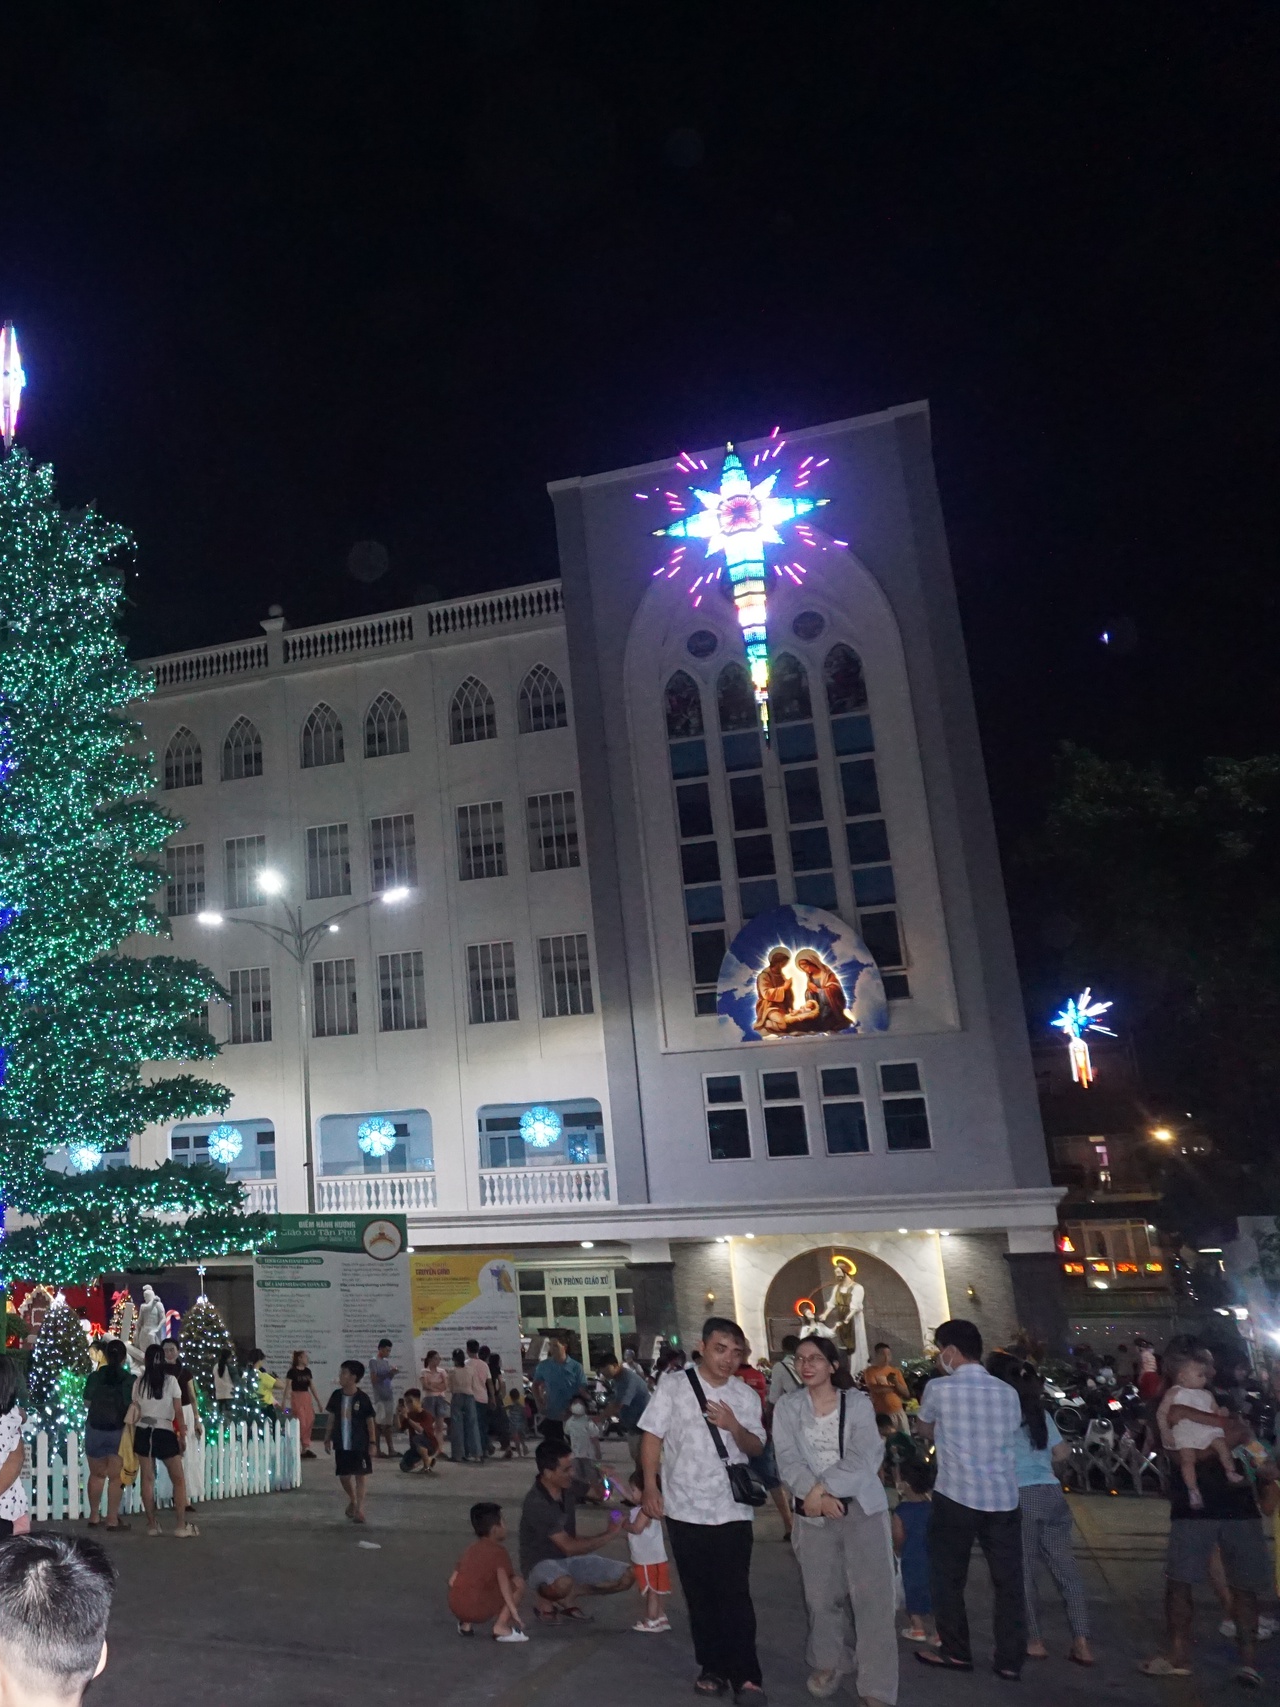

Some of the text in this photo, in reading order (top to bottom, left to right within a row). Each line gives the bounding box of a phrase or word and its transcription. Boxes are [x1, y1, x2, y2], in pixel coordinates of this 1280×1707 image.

[551, 1276, 563, 1286] VĂN
[563, 1275, 584, 1286] PHÒNG
[584, 1275, 600, 1285] GIÁO
